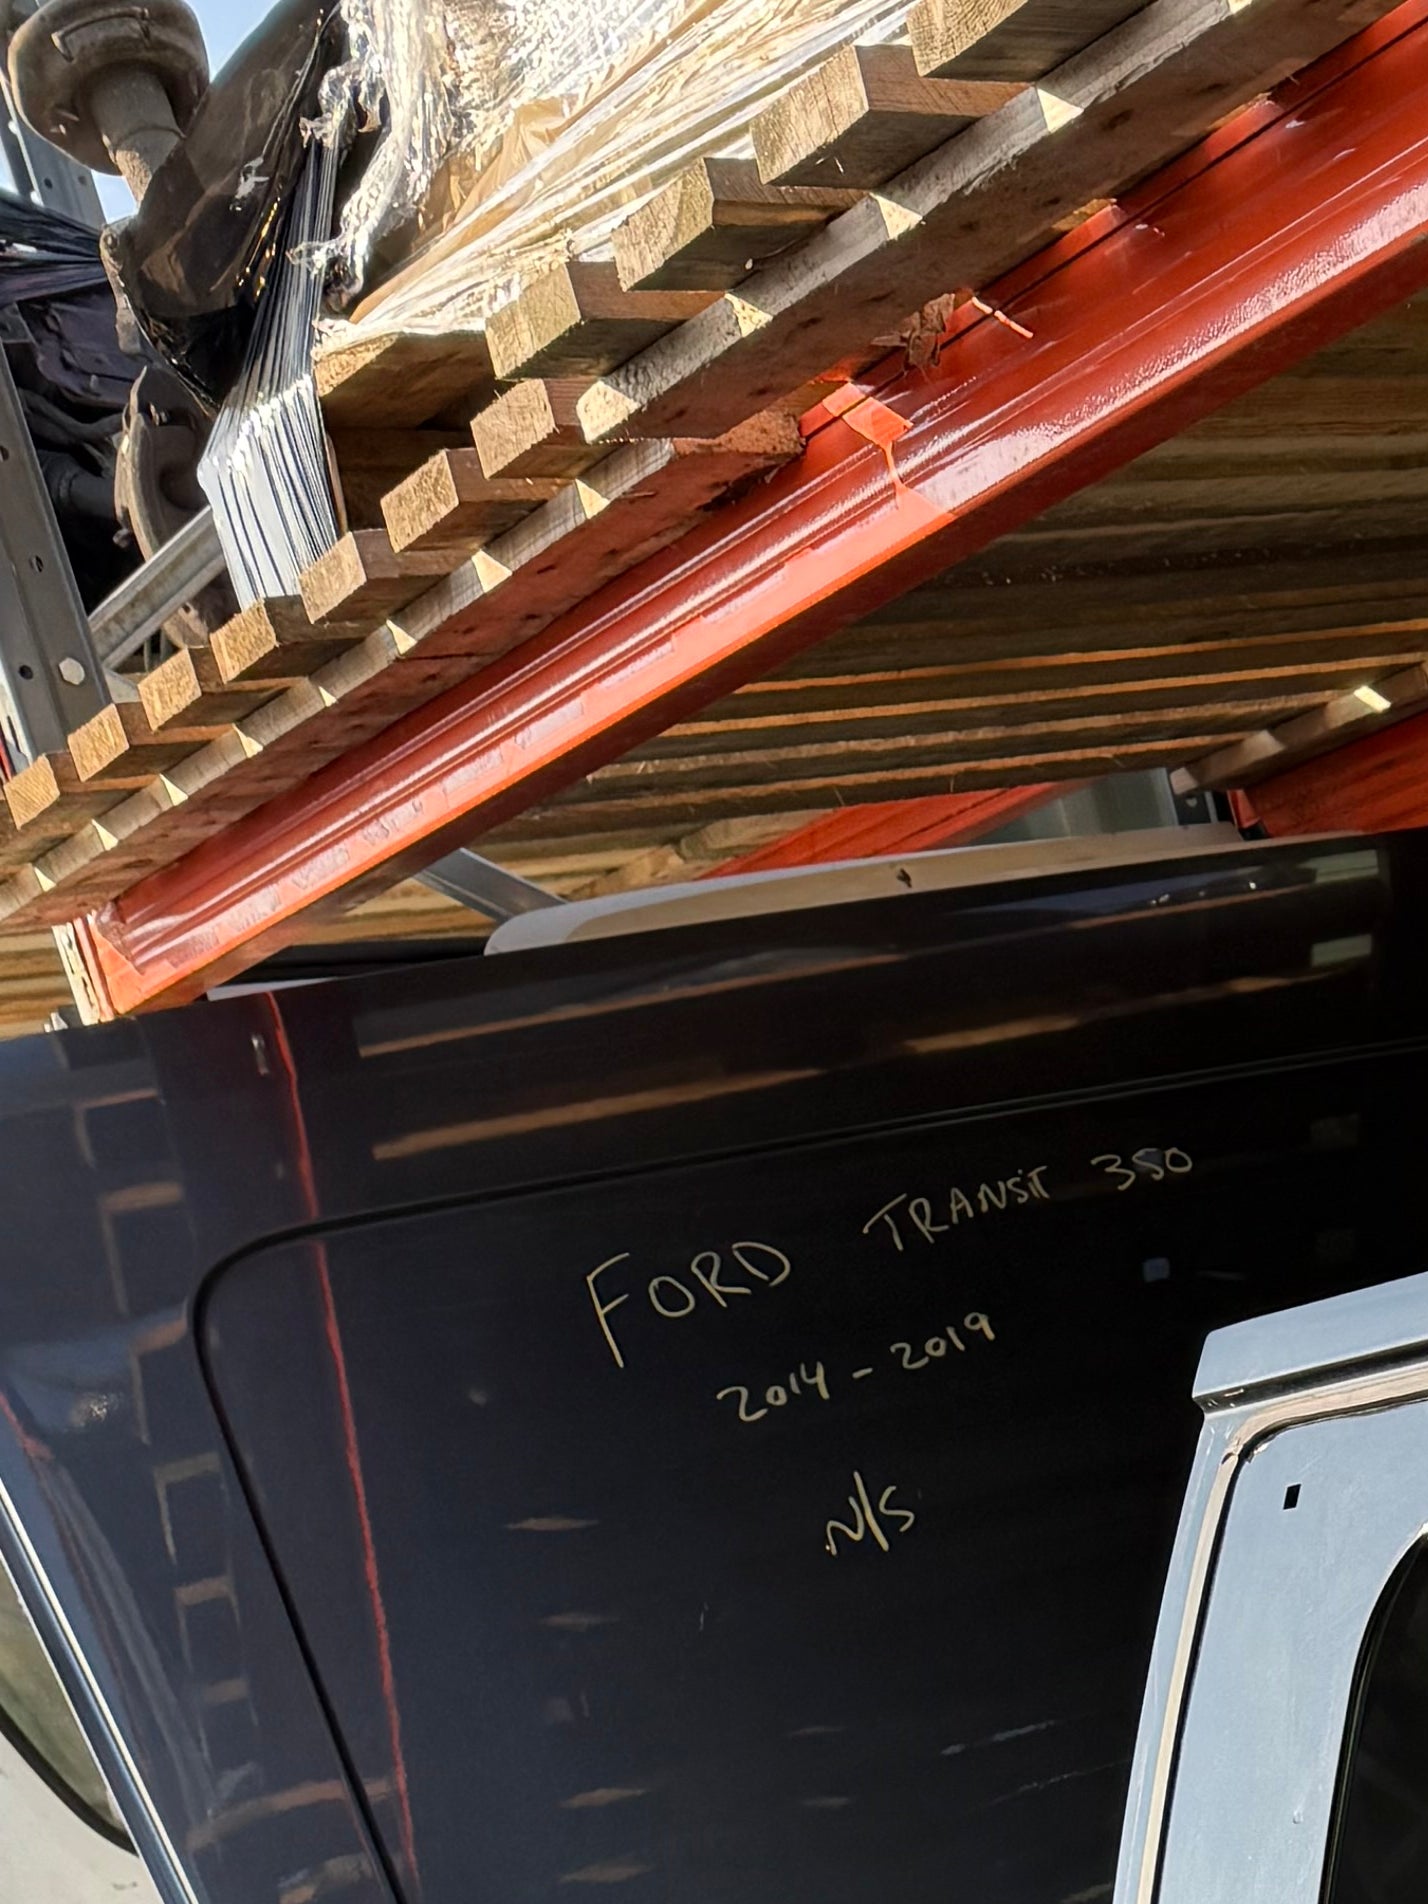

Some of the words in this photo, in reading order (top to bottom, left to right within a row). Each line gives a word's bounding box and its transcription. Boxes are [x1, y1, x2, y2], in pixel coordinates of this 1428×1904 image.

[586, 1241, 791, 1369] FORD
[1091, 1145, 1193, 1190] 350
[716, 1361, 830, 1423] 2014
[890, 1311, 997, 1371] 2019
[824, 1471, 915, 1556] N/S
